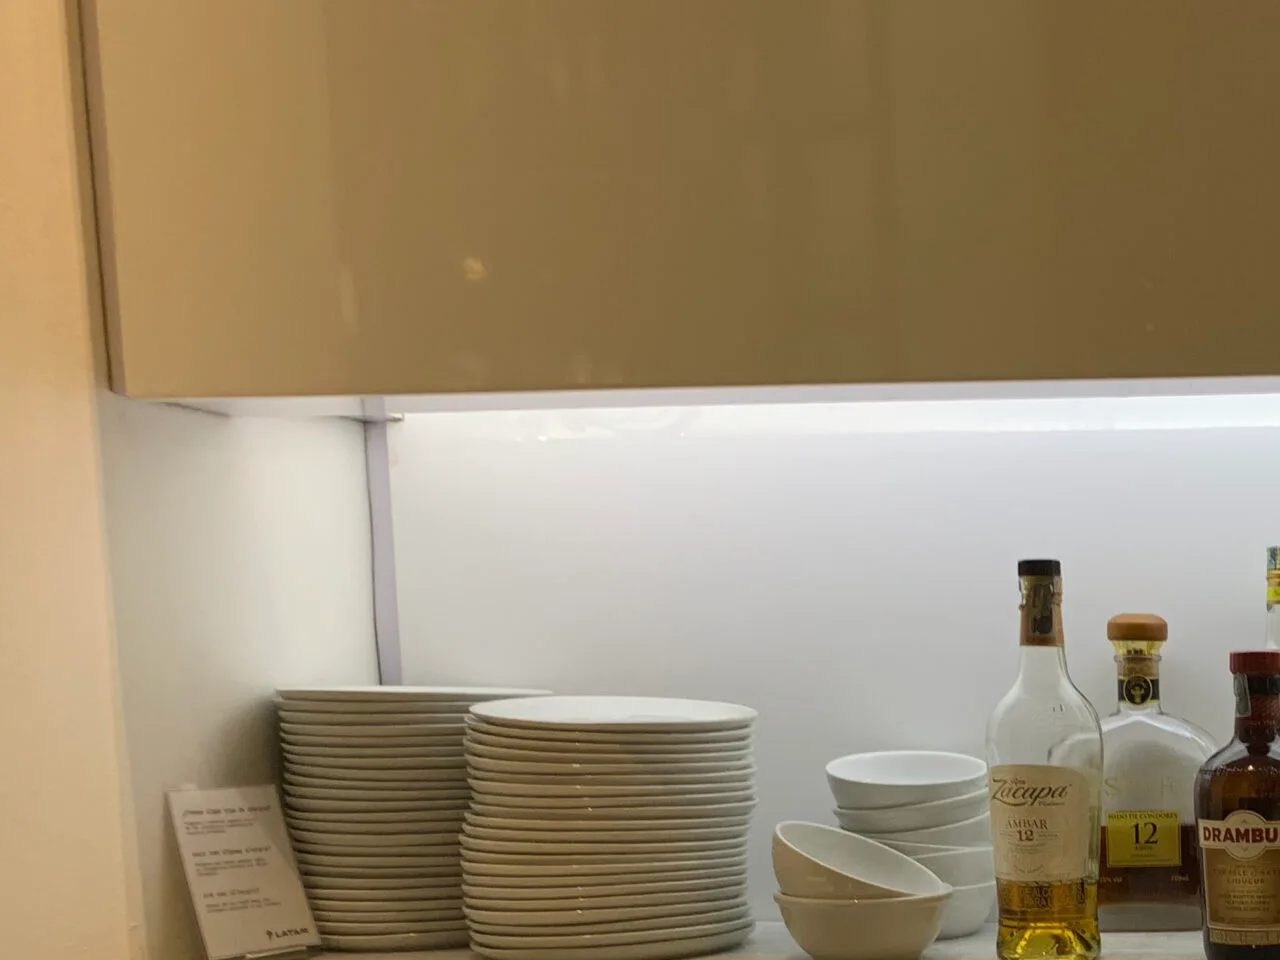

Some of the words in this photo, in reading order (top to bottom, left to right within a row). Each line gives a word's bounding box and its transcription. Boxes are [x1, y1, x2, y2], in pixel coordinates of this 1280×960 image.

[992, 778, 1071, 807] Zacapa
[1006, 818, 1049, 831] AMBAR
[1134, 822, 1158, 845] 12
[1017, 829, 1034, 842] 12
